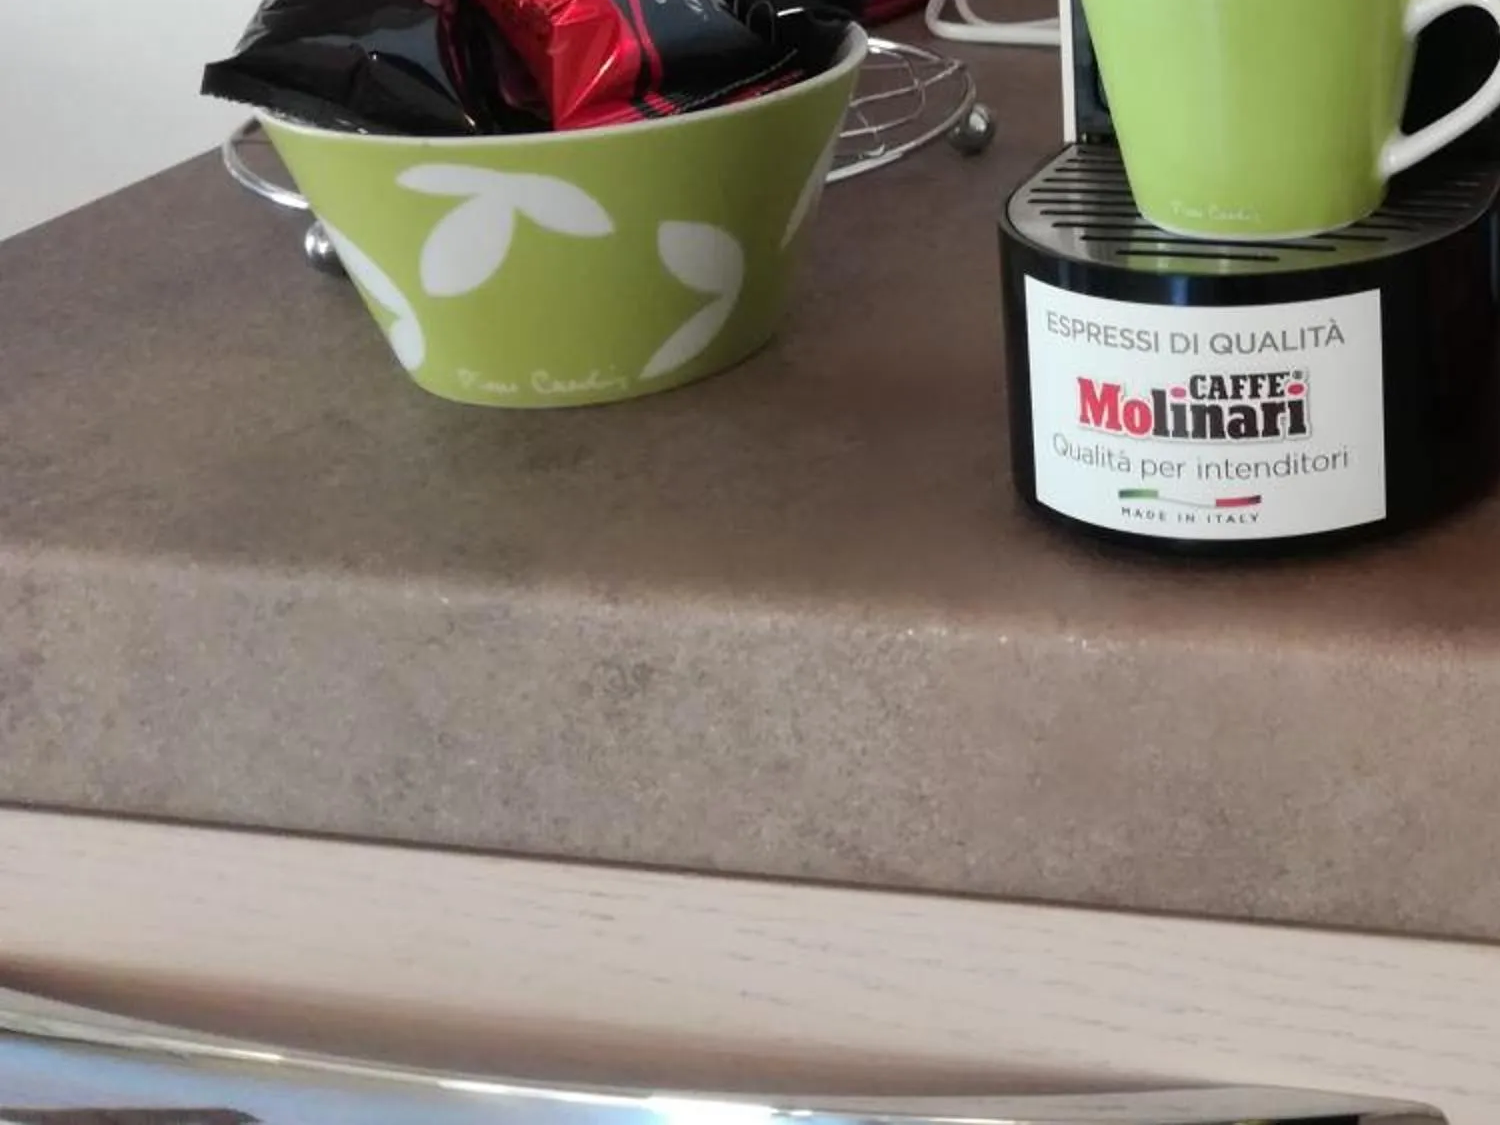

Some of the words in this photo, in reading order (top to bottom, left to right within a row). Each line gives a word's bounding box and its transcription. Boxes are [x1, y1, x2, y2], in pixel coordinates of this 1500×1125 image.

[1046, 310, 1159, 352] ESPRESSI
[1170, 332, 1199, 354] DI
[1209, 318, 1346, 356] QUALITÀ
[1077, 376, 1308, 439] Molinari
[1052, 433, 1131, 473] Qualità
[1141, 458, 1186, 481] per
[1197, 445, 1350, 481] intenditori
[1121, 507, 1166, 522] MADE
[1177, 513, 1196, 523] IN
[1206, 512, 1260, 524] ITALY
